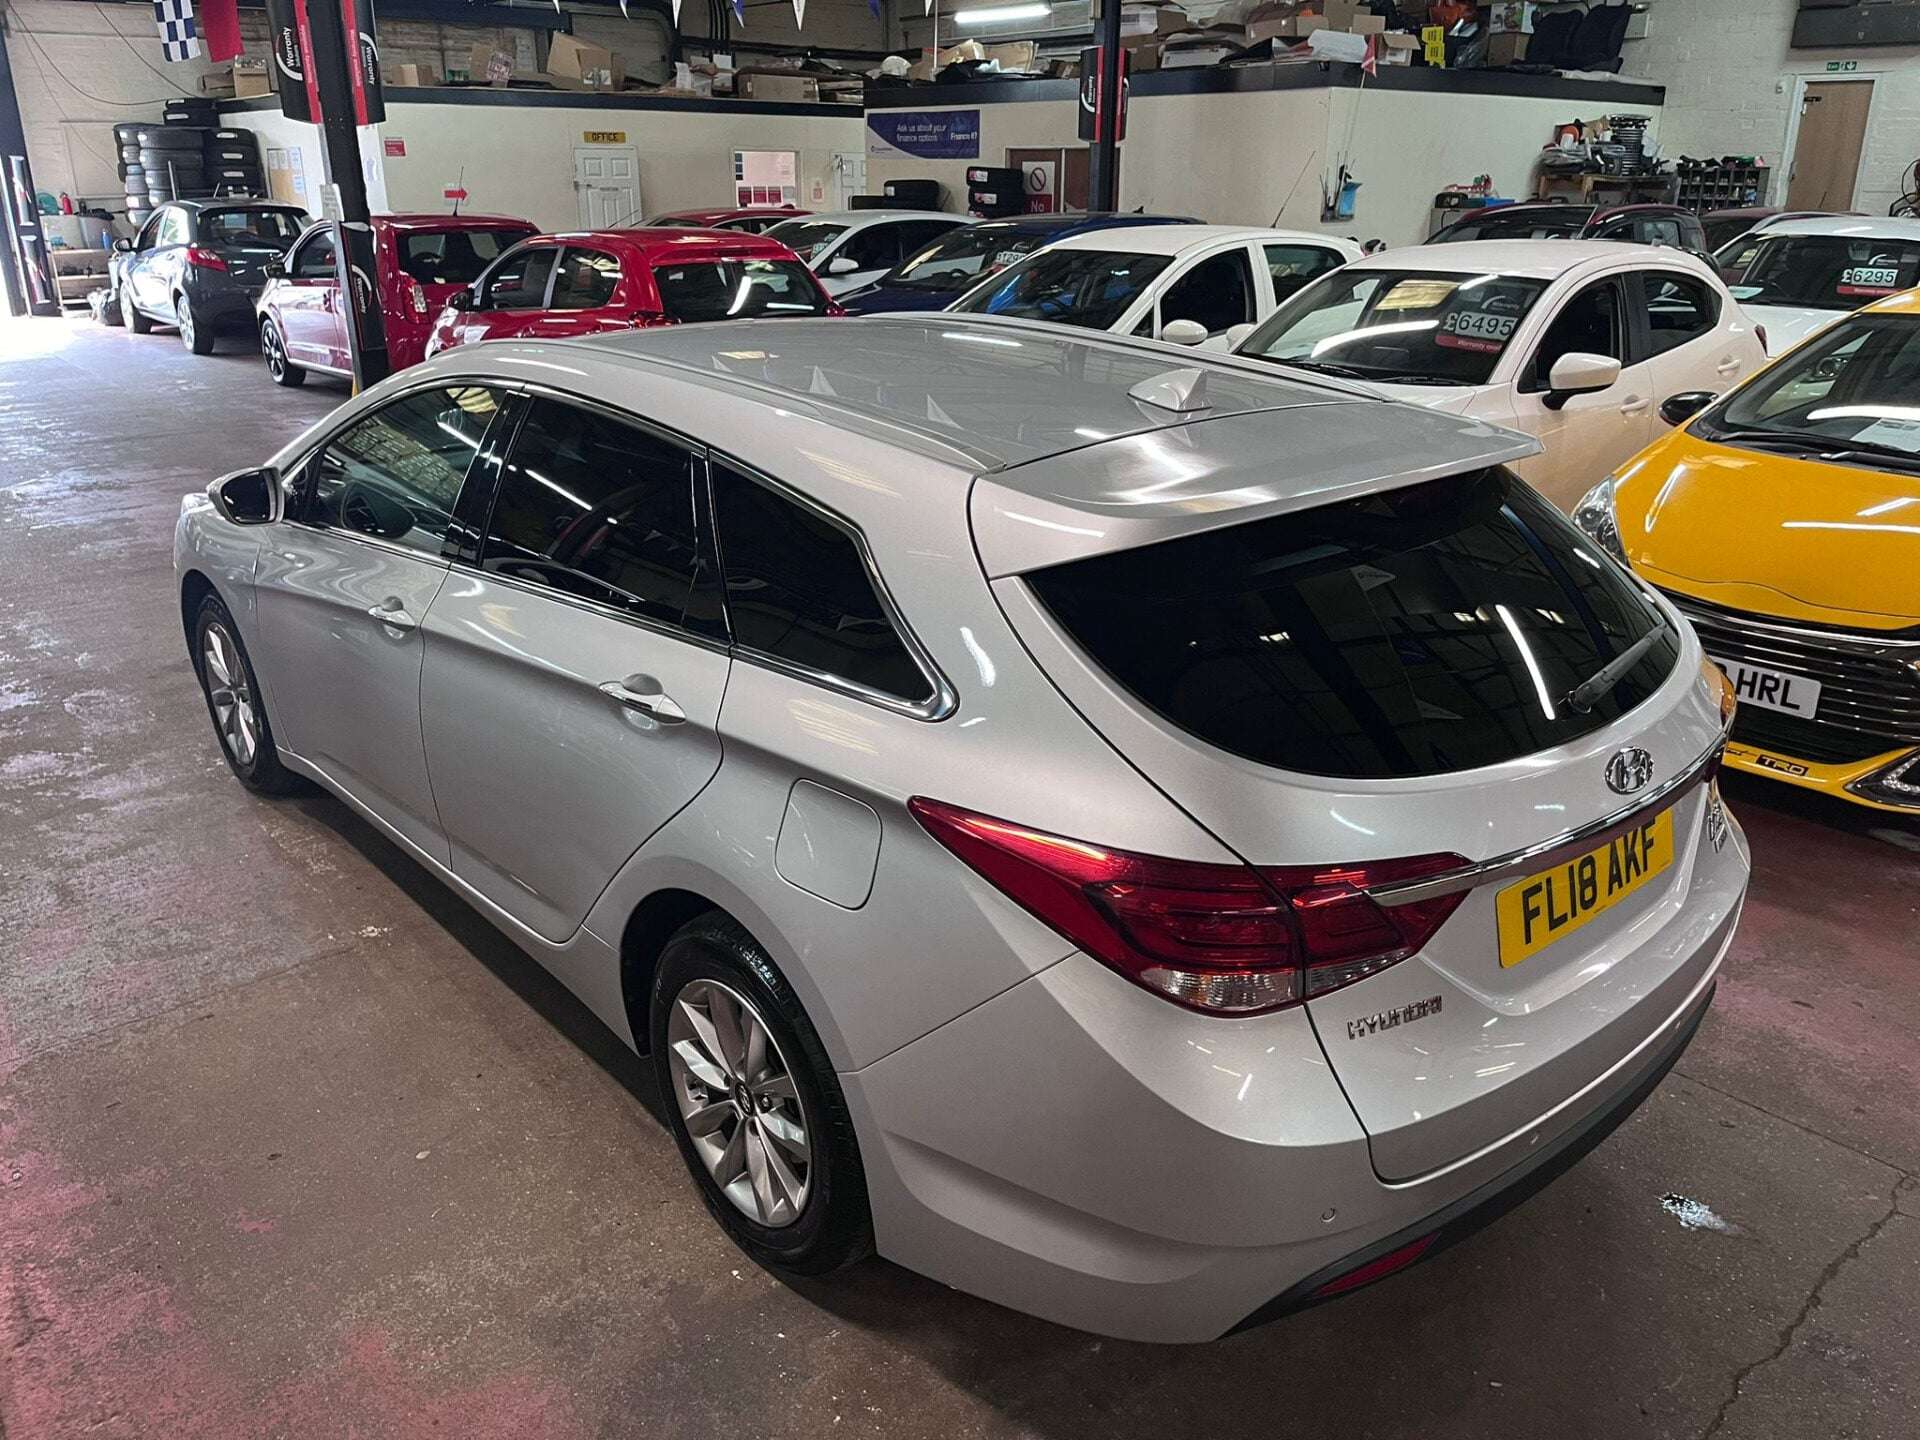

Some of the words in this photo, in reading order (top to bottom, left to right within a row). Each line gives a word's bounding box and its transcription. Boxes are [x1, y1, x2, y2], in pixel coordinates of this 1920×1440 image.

[283, 26, 294, 68] Warranty
[591, 132, 618, 142] OFFICE
[1030, 200, 1045, 213] No
[1841, 268, 1895, 284] £6295
[1443, 312, 1514, 336] £6495
[1735, 668, 1800, 710] HRL
[1522, 854, 1599, 945] FL18
[1607, 815, 1657, 897] AKF
[1346, 994, 1443, 1041] HYUNDAI
